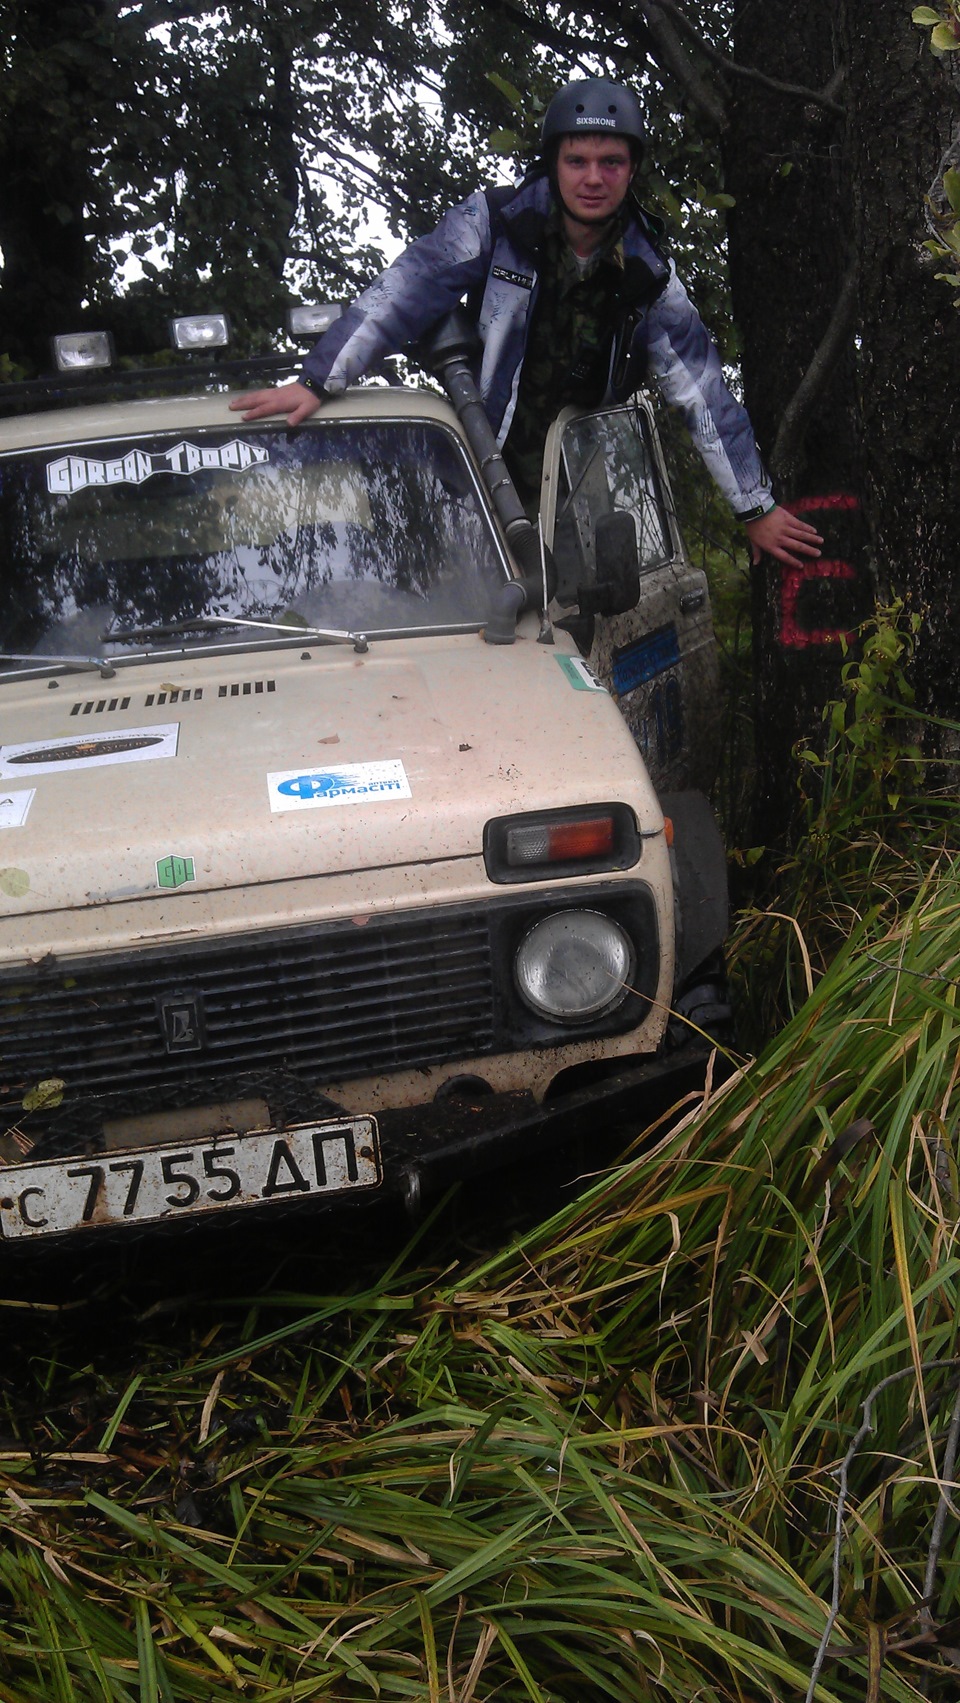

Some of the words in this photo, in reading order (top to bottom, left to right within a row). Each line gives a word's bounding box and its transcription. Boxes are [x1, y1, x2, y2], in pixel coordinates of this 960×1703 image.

[576, 116, 616, 128] SIXSIXONE
[48, 450, 152, 493] GORGAN
[165, 440, 268, 474] TROPHY
[277, 774, 401, 800] Фармасіті
[67, 1147, 241, 1222] 7755
[262, 1128, 359, 1198] ДП
